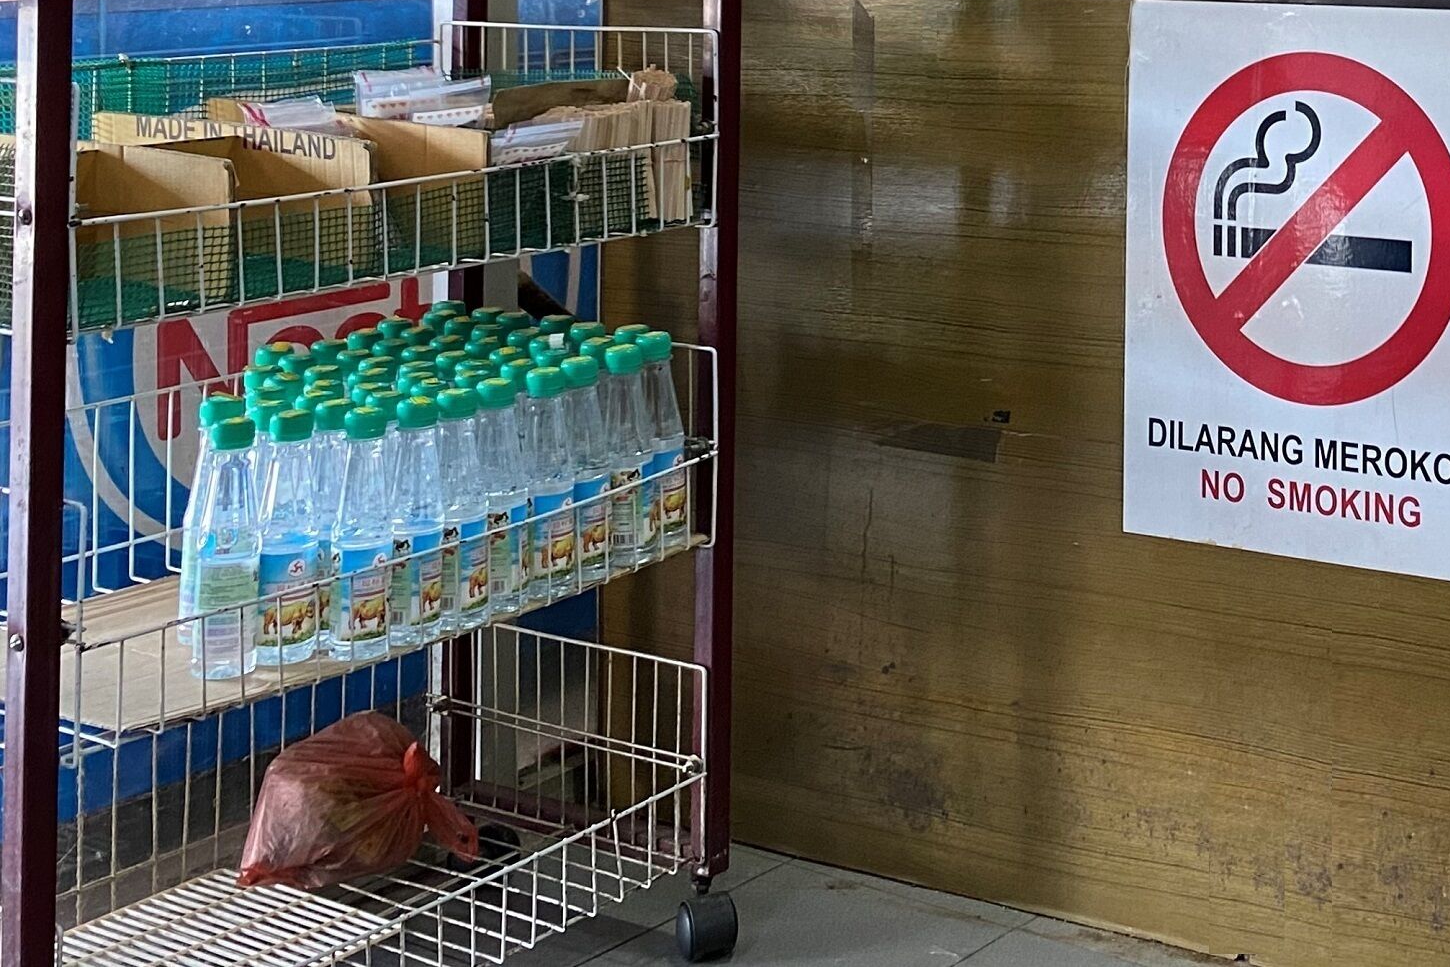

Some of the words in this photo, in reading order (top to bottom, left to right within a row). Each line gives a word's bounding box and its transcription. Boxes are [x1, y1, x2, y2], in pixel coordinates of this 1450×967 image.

[136, 116, 195, 140] MADE
[204, 123, 222, 138] IN
[233, 127, 336, 161] THAILAND
[1148, 416, 1303, 466] DILARANG
[1201, 469, 1245, 504] NO
[1268, 480, 1422, 528] SMOKING
